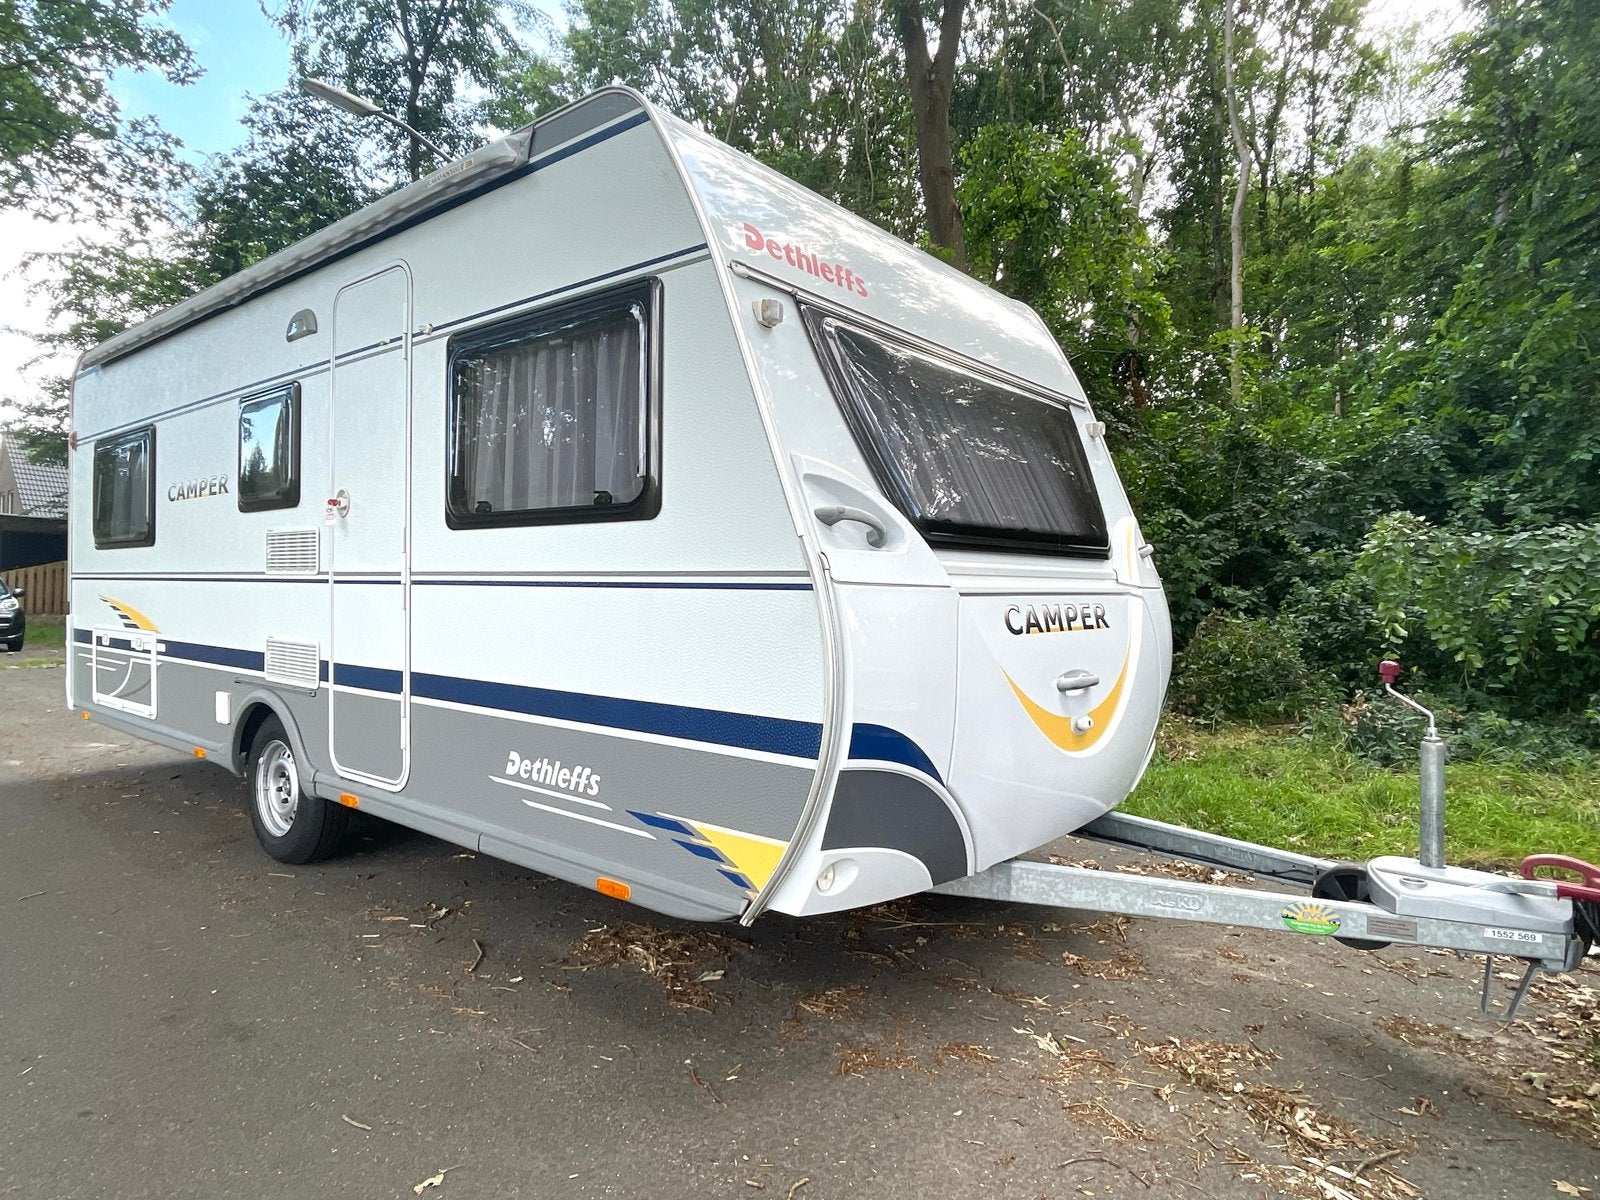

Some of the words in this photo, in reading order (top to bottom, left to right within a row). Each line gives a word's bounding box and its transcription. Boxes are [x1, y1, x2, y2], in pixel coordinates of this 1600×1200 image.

[743, 222, 868, 298] Dethleffs
[167, 473, 229, 502] CAMPER
[1003, 602, 1110, 636] CAMPER
[505, 750, 601, 796] Dethleffs
[1491, 930, 1515, 939] 1552
[1517, 932, 1537, 942] 569
